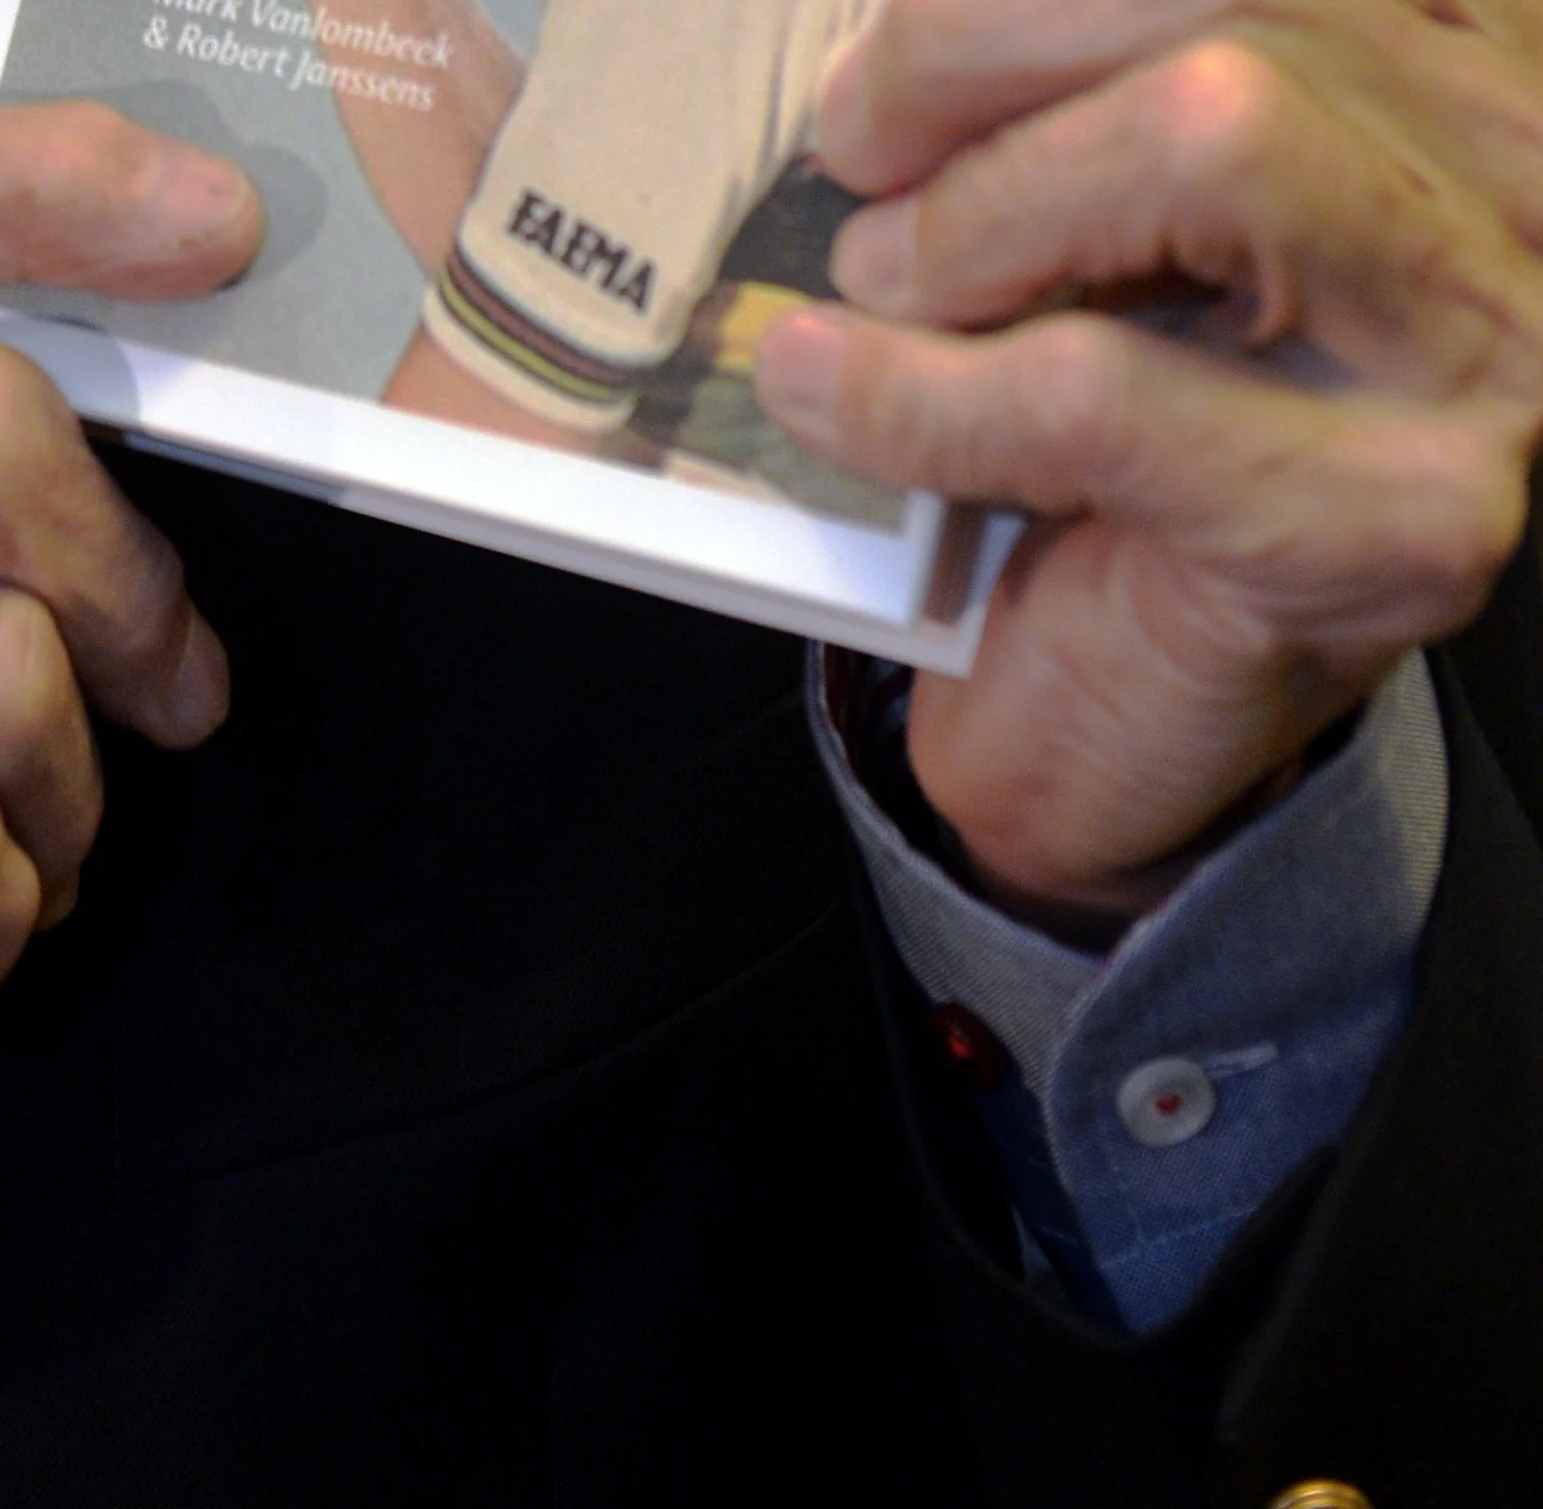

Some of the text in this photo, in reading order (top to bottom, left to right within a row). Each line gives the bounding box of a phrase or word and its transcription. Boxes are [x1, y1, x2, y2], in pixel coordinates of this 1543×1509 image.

[143, 15, 435, 112] & Robert Janssens
[509, 189, 653, 311] FAEMA
